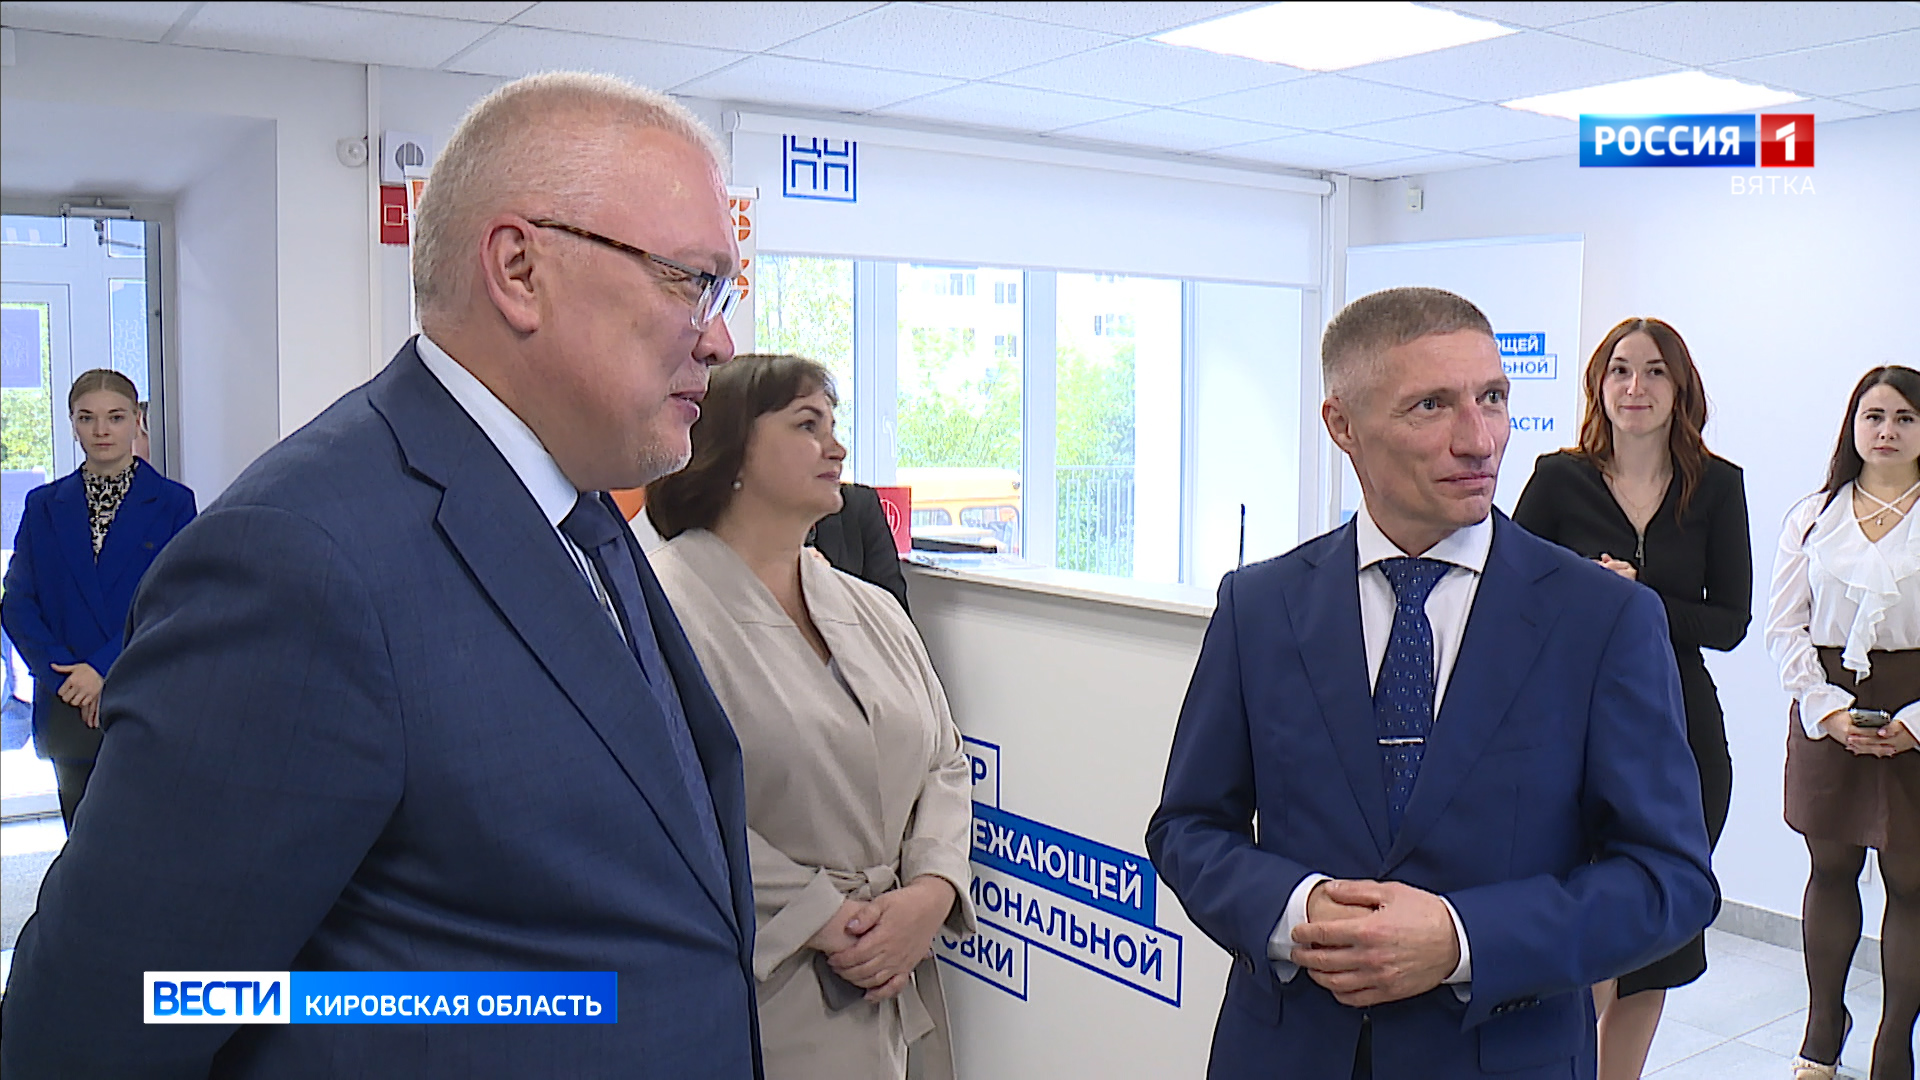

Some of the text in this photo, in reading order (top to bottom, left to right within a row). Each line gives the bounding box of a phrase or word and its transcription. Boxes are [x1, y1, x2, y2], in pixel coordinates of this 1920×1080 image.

[1510, 417, 1554, 431] АСТИ
[966, 754, 988, 785] Р
[972, 817, 1143, 910] ЕЖАЮЩЕЙ
[933, 934, 1013, 978] ВКИ
